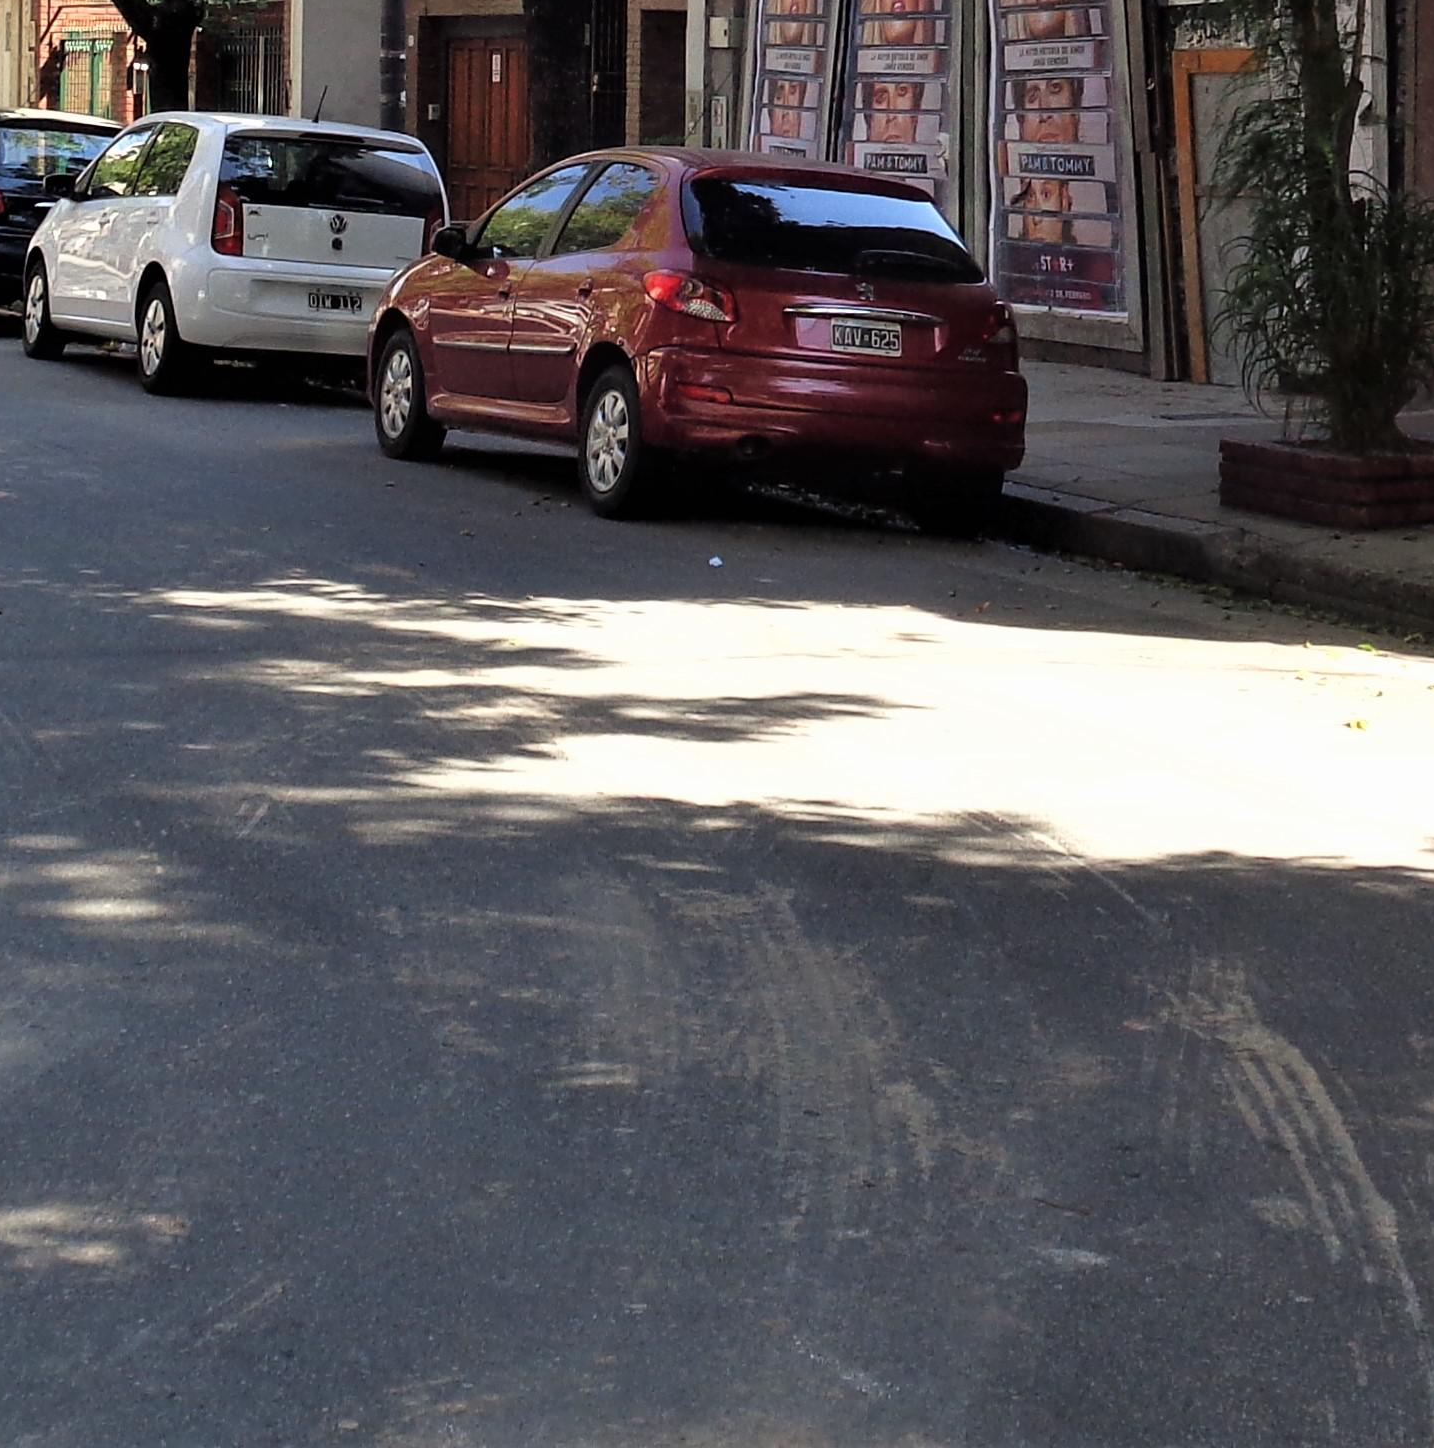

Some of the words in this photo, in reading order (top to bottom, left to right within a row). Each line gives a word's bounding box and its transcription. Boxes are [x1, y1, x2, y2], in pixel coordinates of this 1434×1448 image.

[865, 155, 885, 170] PAM
[893, 155, 925, 171] TOMMY
[1021, 155, 1041, 171] PAM
[1050, 155, 1092, 172] TOMMY
[834, 326, 862, 347] KAV
[871, 330, 900, 350] 625
